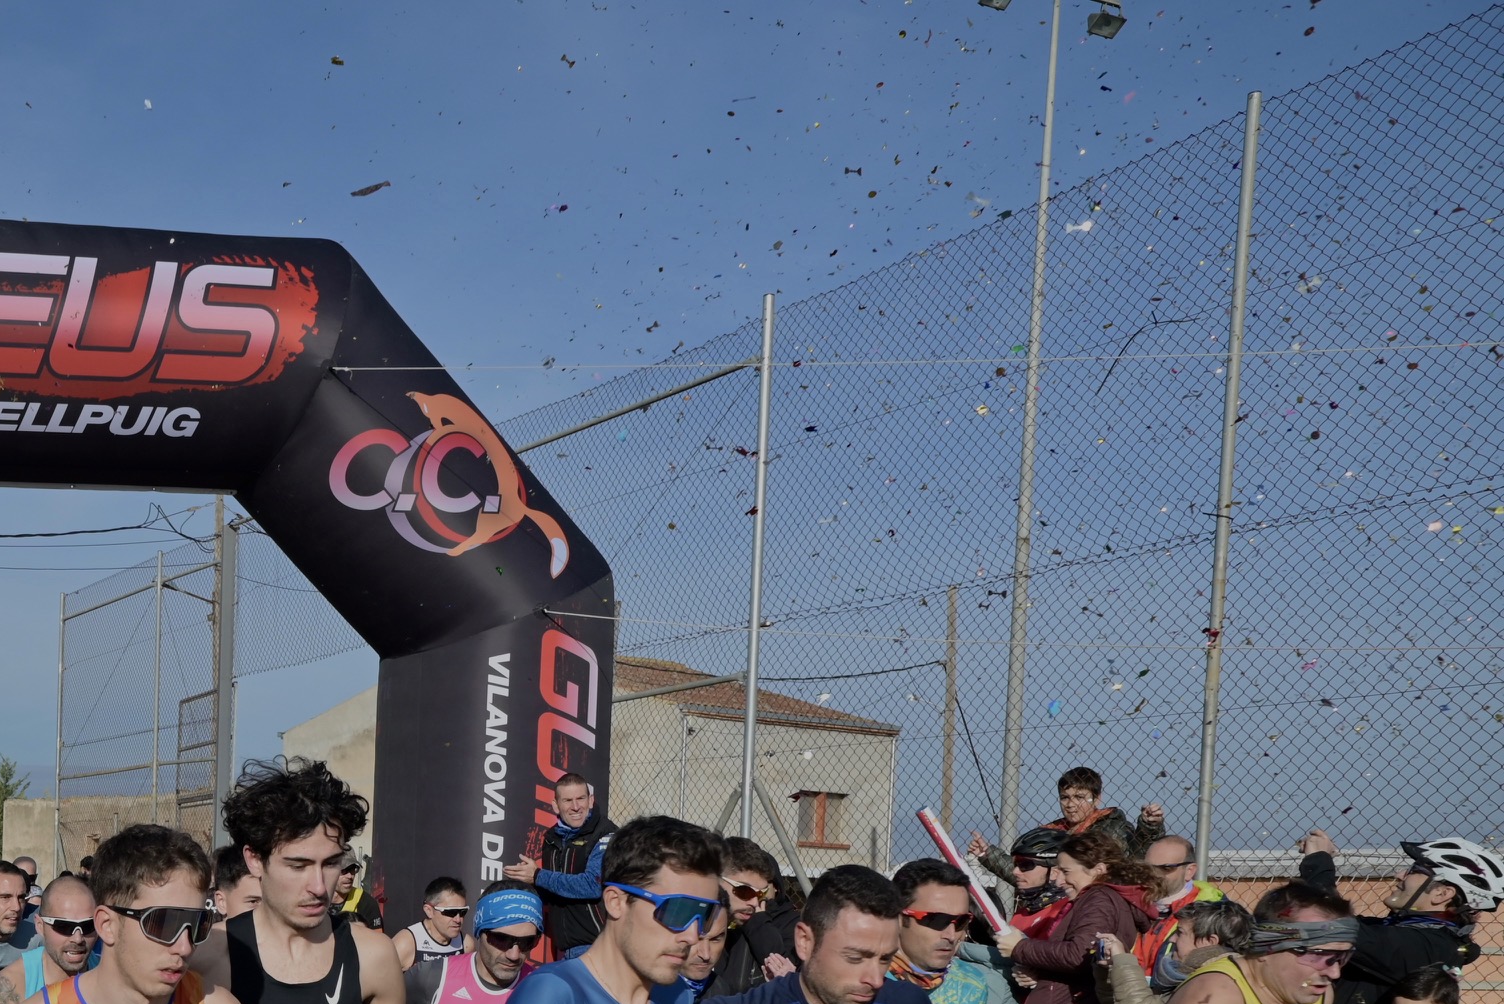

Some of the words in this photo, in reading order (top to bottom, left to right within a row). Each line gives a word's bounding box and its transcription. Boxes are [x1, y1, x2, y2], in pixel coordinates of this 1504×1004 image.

[482, 653, 511, 823] VILANOVA
[481, 832, 504, 881] DE
[493, 894, 537, 904] BROOKS
